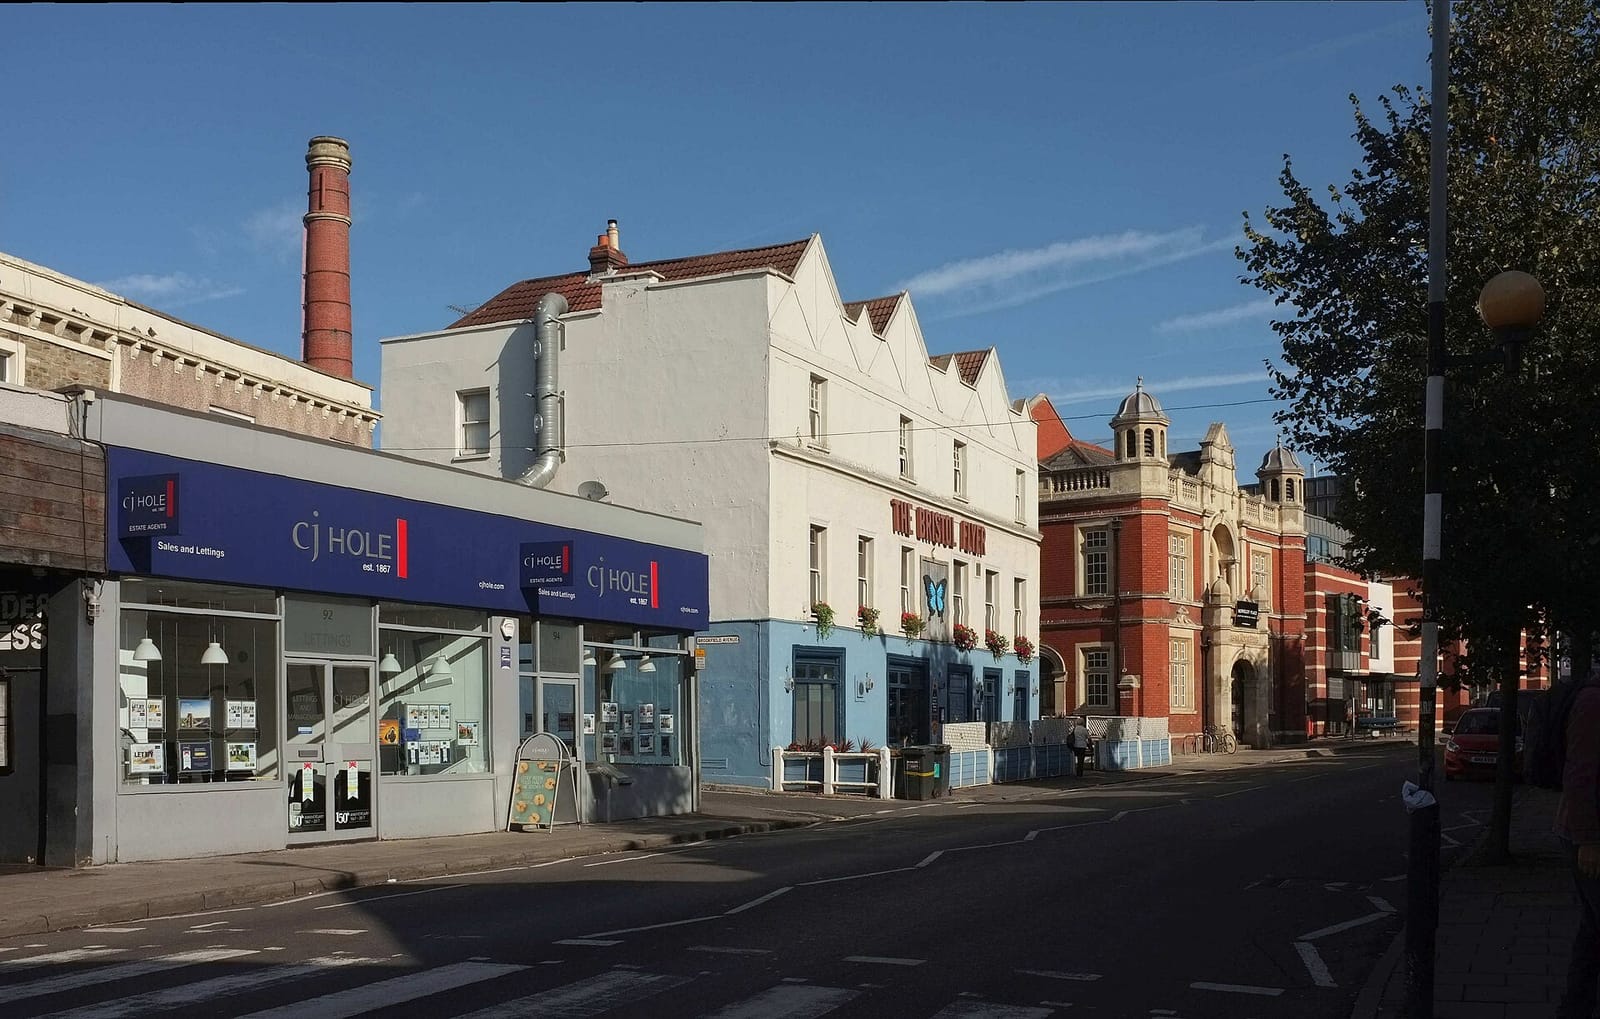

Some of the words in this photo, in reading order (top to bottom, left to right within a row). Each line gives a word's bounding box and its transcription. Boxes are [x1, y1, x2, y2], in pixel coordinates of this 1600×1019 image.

[137, 494, 166, 508] HOLE
[129, 524, 146, 532] ESTATE
[147, 522, 167, 531] AGENTS
[890, 499, 914, 538] THE
[915, 507, 957, 549] BRISTOL
[959, 520, 987, 558] FLYER
[292, 510, 320, 562] cj
[328, 527, 392, 560] HOLE
[158, 541, 179, 554] Sales
[180, 545, 195, 555] and
[196, 545, 225, 558] Lettings
[536, 555, 562, 566] HOLE
[362, 563, 375, 572] est.
[376, 564, 392, 574] 1867
[587, 556, 605, 598] cj
[609, 569, 649, 595] HOLE
[538, 587, 551, 596] Sales
[322, 609, 333, 621] 92
[552, 631, 560, 640] 94
